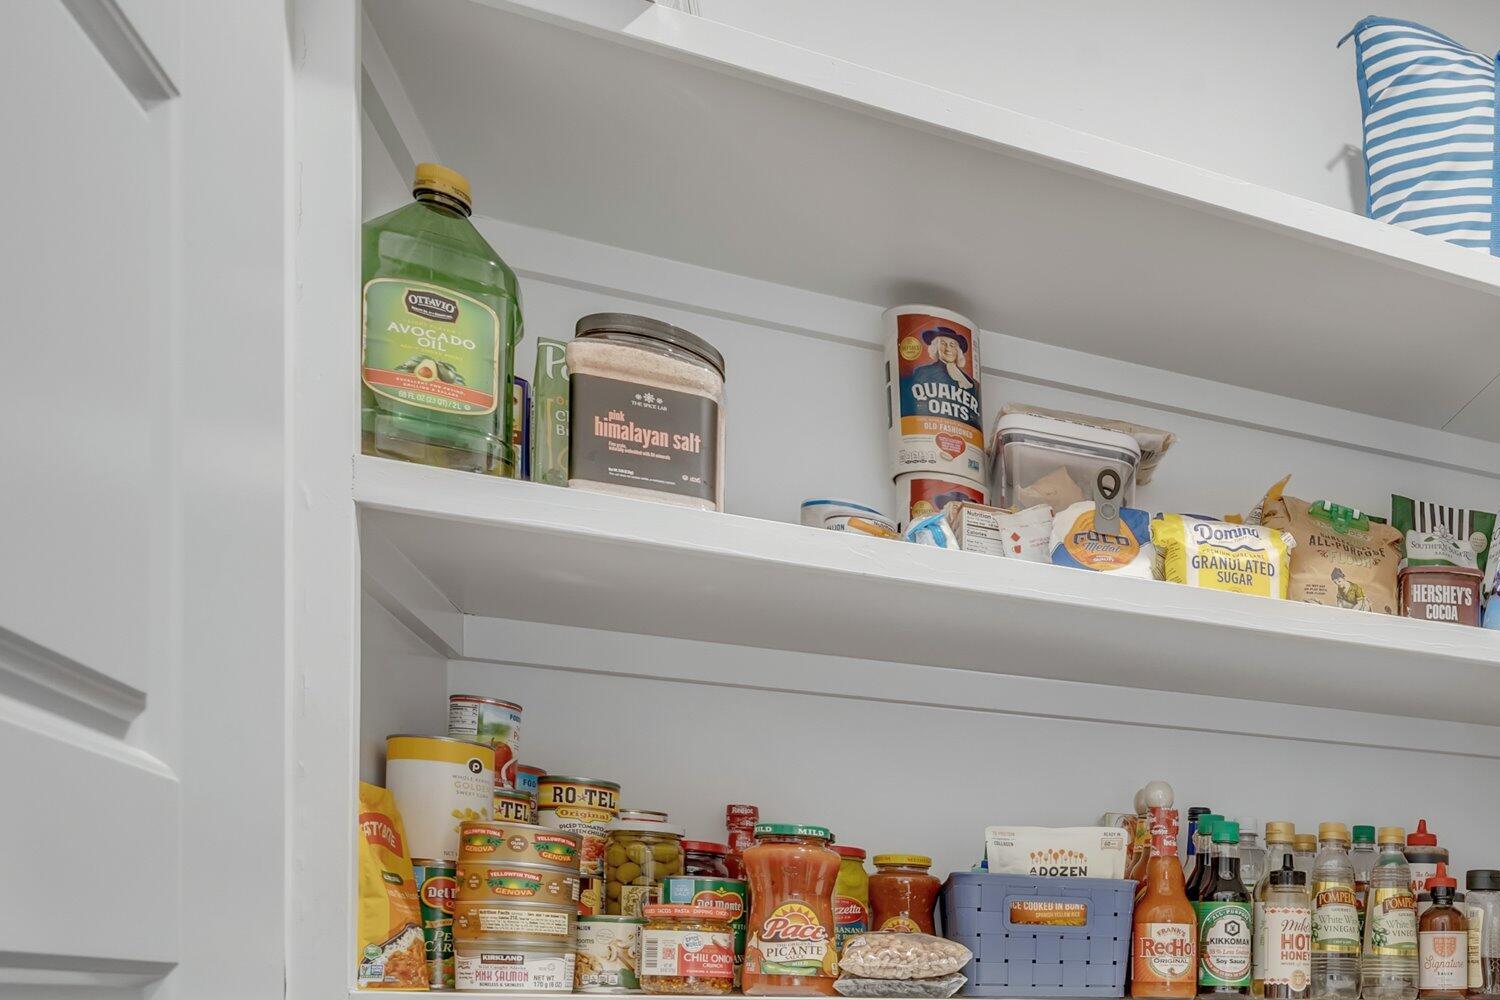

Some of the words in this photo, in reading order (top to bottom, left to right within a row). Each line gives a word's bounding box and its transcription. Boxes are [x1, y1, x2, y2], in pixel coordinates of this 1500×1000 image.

[408, 294, 456, 313] OTTAVIO
[387, 321, 476, 350] AVOCADO
[417, 337, 447, 352] OIL
[911, 382, 980, 416] QUAKER
[608, 410, 625, 422] pink
[928, 399, 970, 421] OATS
[924, 422, 937, 430] OLD
[594, 416, 669, 449] himalayan
[673, 432, 701, 453] salt
[967, 510, 992, 519] Nutrition
[1193, 523, 1260, 540] Domino
[1192, 555, 1275, 577] GRANULATED
[1217, 572, 1253, 586] SUGAR
[1412, 584, 1472, 606] HERSHEY'S
[1426, 603, 1459, 621] COCOA
[559, 809, 610, 820] Original
[798, 828, 825, 836] MILD
[542, 851, 571, 861] GENOVA
[490, 871, 525, 879] YELLOWFIN
[525, 873, 540, 882] TUNA
[1039, 866, 1088, 877] DOZEN
[428, 887, 449, 898] Del
[495, 887, 533, 896] GENOVA
[715, 900, 742, 911] Monte
[1023, 902, 1052, 911] COOKED
[1319, 914, 1343, 924] White
[1386, 919, 1407, 928] White
[762, 917, 826, 942] Pace
[1157, 926, 1187, 937] FRANK'S
[1140, 937, 1196, 957] RedHot
[1209, 937, 1250, 945] KIKKOMAN
[1280, 934, 1311, 950] HOT
[683, 952, 709, 962] CHILI
[766, 945, 823, 957] PICANTE
[1280, 951, 1311, 960] HONEY
[1424, 955, 1465, 969] Signature
[475, 970, 492, 981] PINK
[495, 971, 529, 982] SALMON
